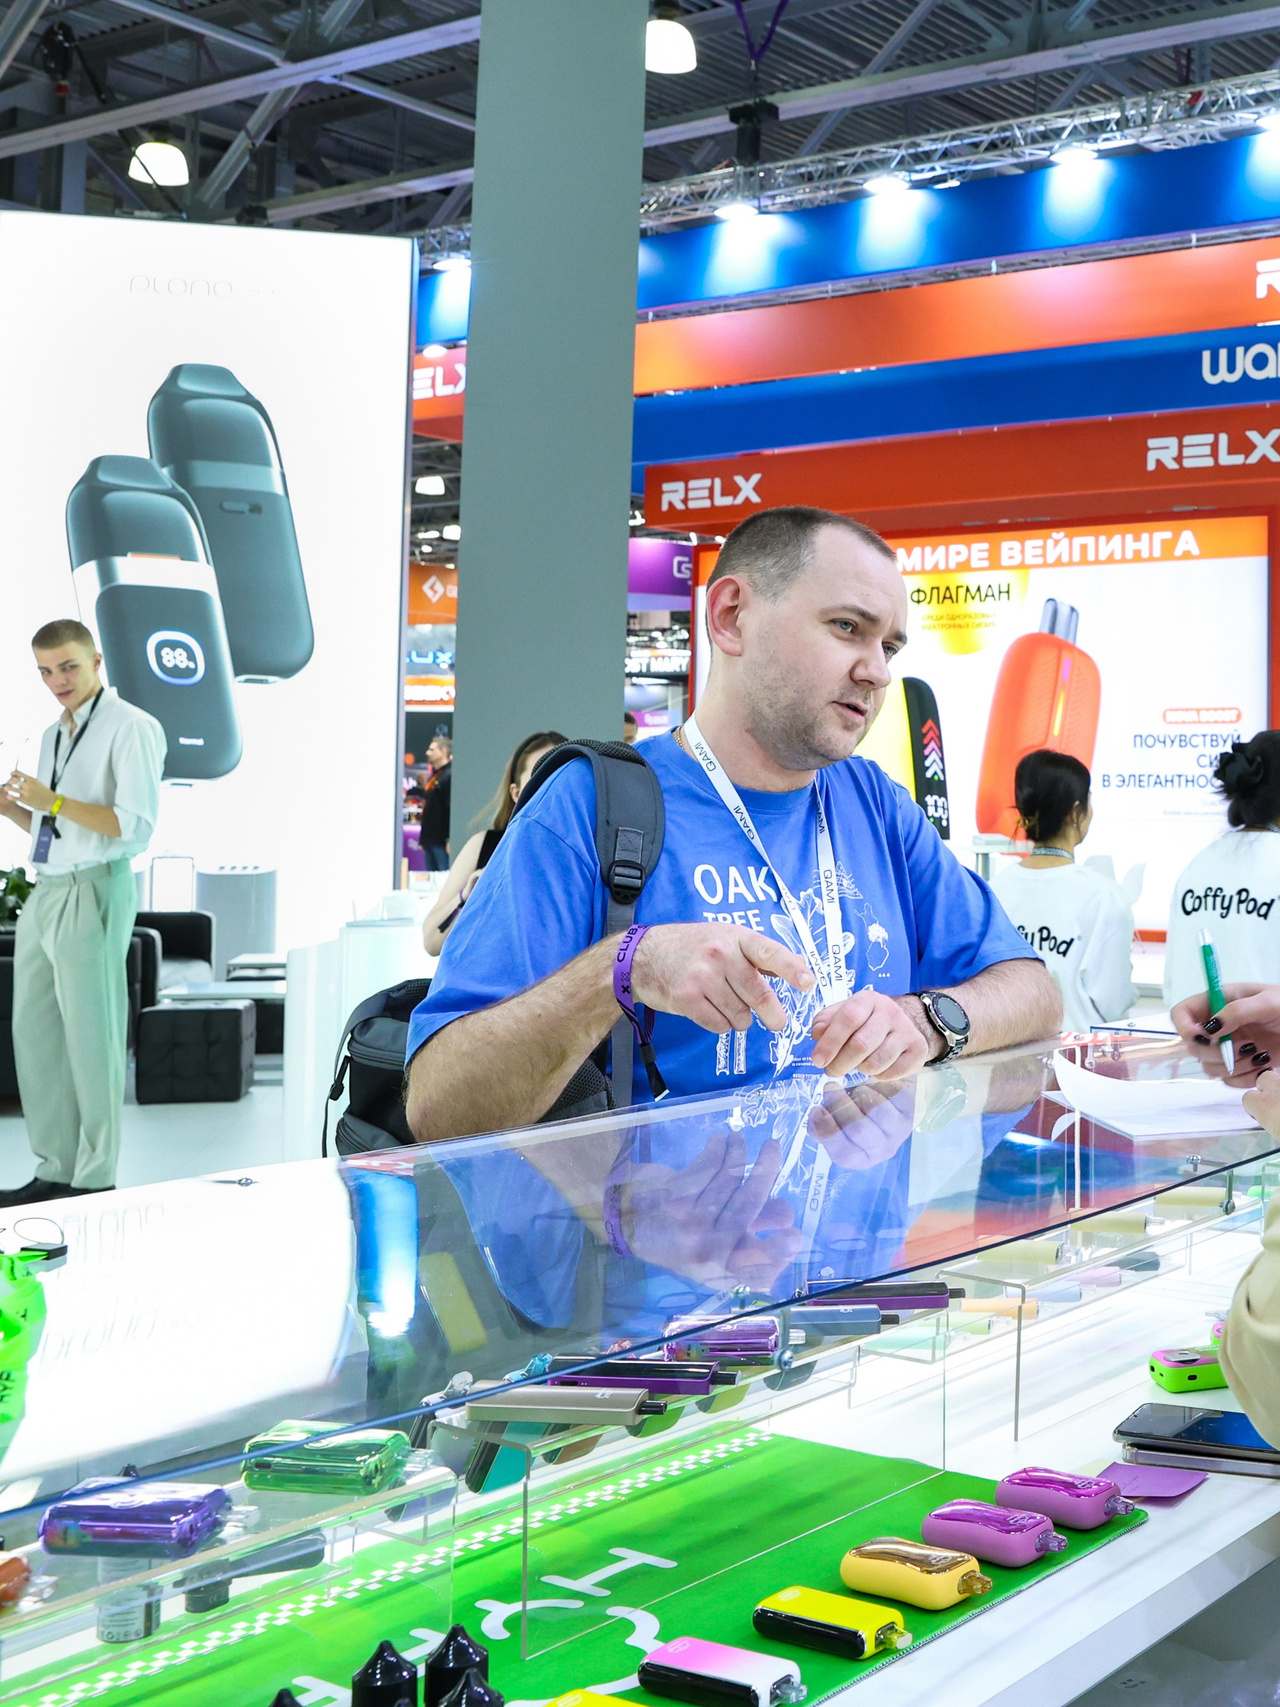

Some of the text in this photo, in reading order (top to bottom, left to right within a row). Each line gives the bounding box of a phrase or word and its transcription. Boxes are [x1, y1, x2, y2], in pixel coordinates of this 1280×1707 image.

[661, 472, 762, 512] RELX
[897, 529, 1201, 572] МИРЕ ВЕЙПИНГА
[910, 582, 1011, 605] ФЛАГМАН
[1133, 728, 1241, 749] ПОЧУВСТВУЙ
[1101, 775, 1111, 789] В
[693, 863, 779, 906] OAK
[1180, 886, 1276, 920] Coffy Pod
[1037, 926, 1075, 958] Pod
